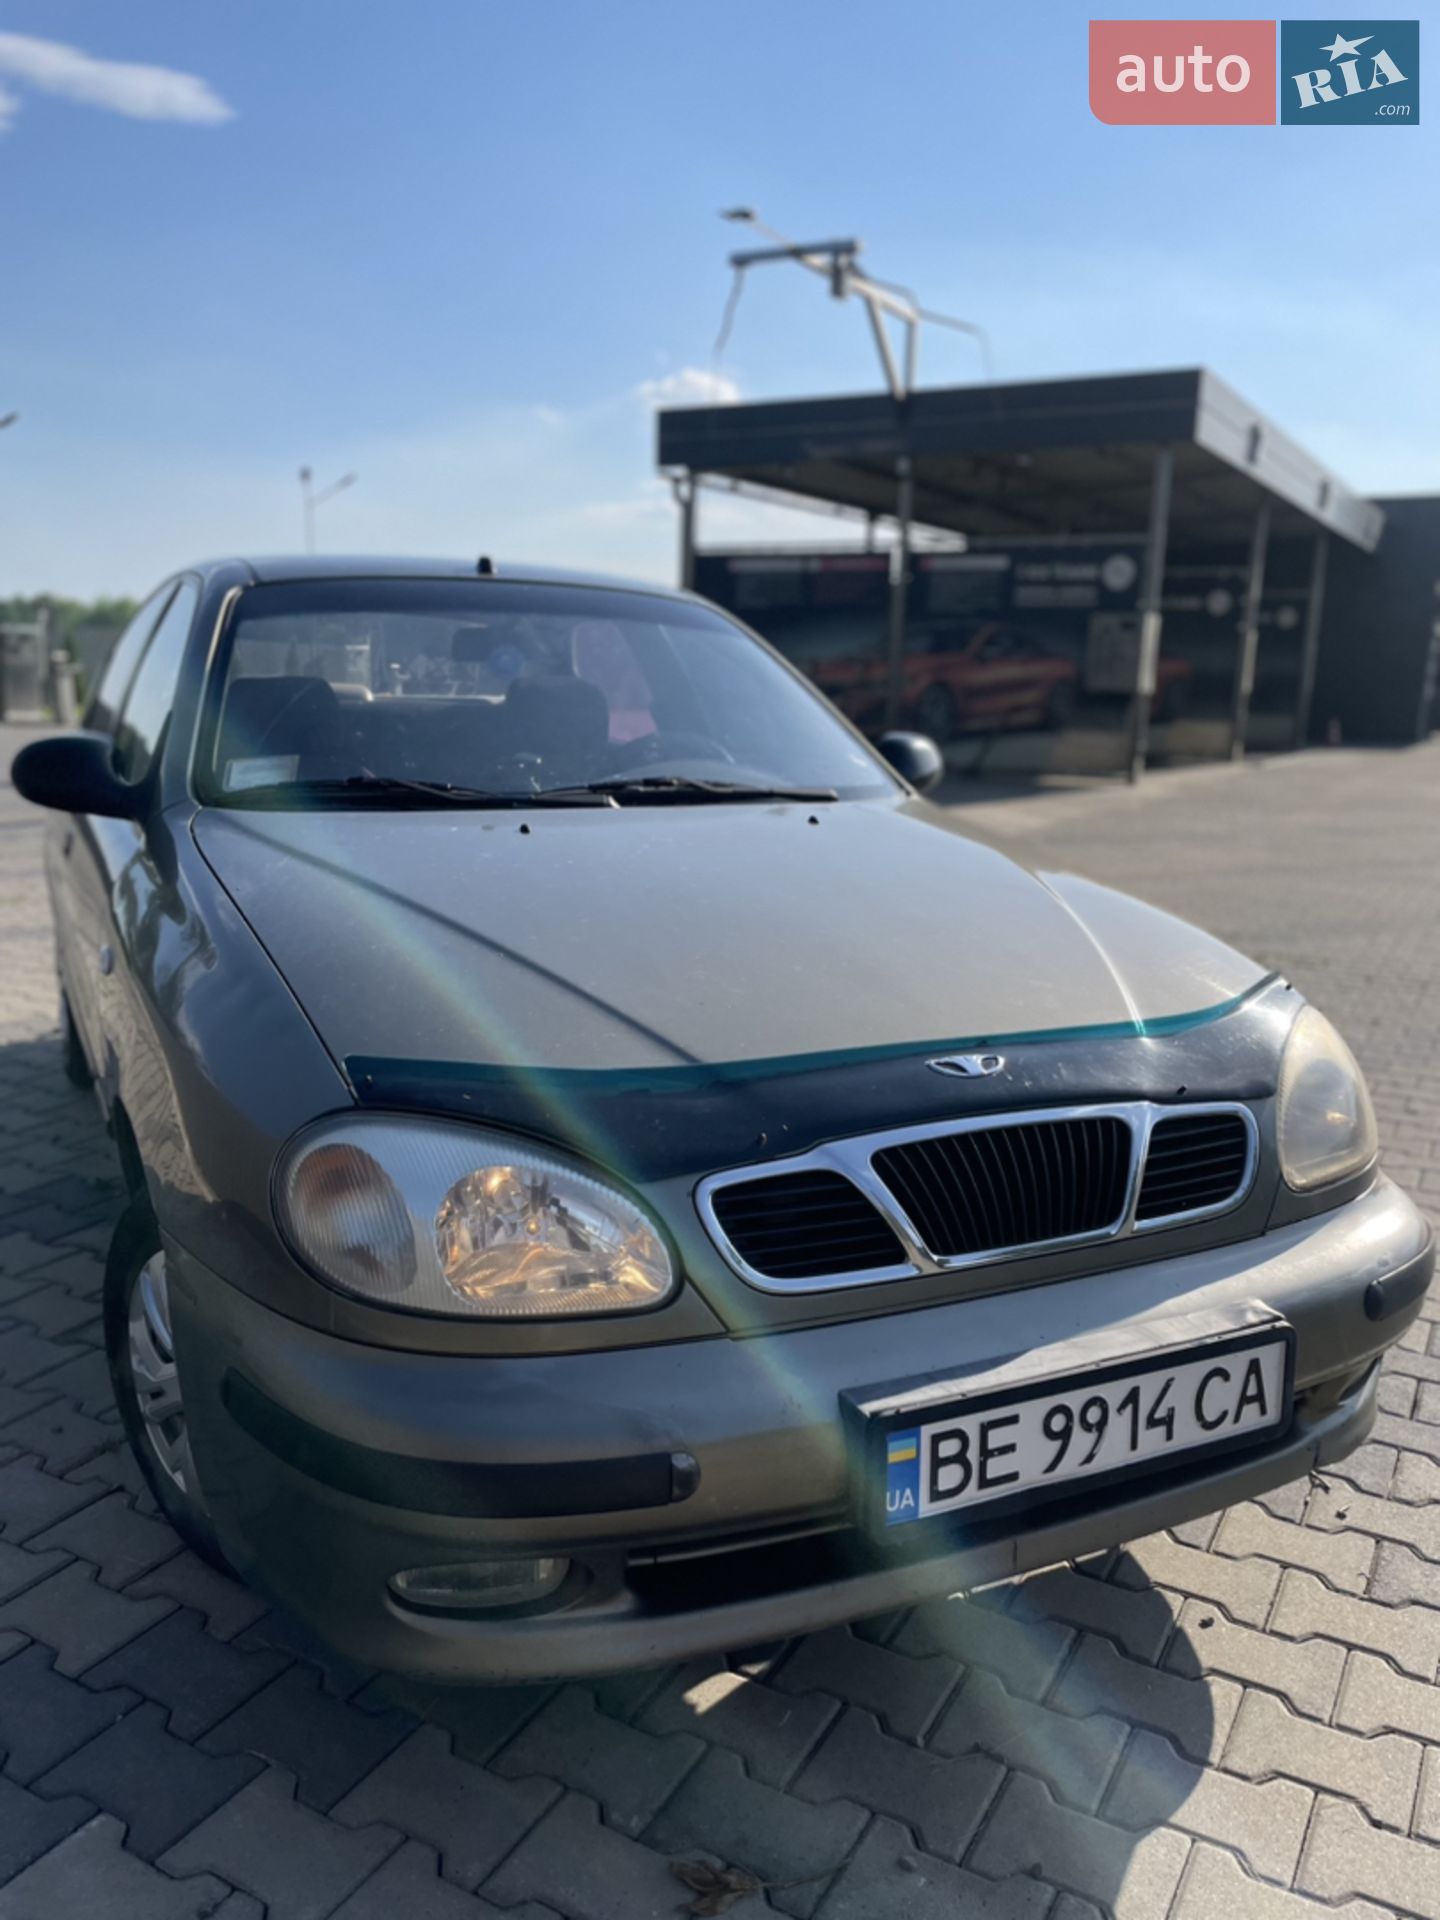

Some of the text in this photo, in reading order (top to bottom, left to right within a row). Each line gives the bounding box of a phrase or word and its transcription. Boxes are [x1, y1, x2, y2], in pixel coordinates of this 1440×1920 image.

[929, 1357, 1268, 1503] BE 9914 CA
[886, 1488, 914, 1512] UA
